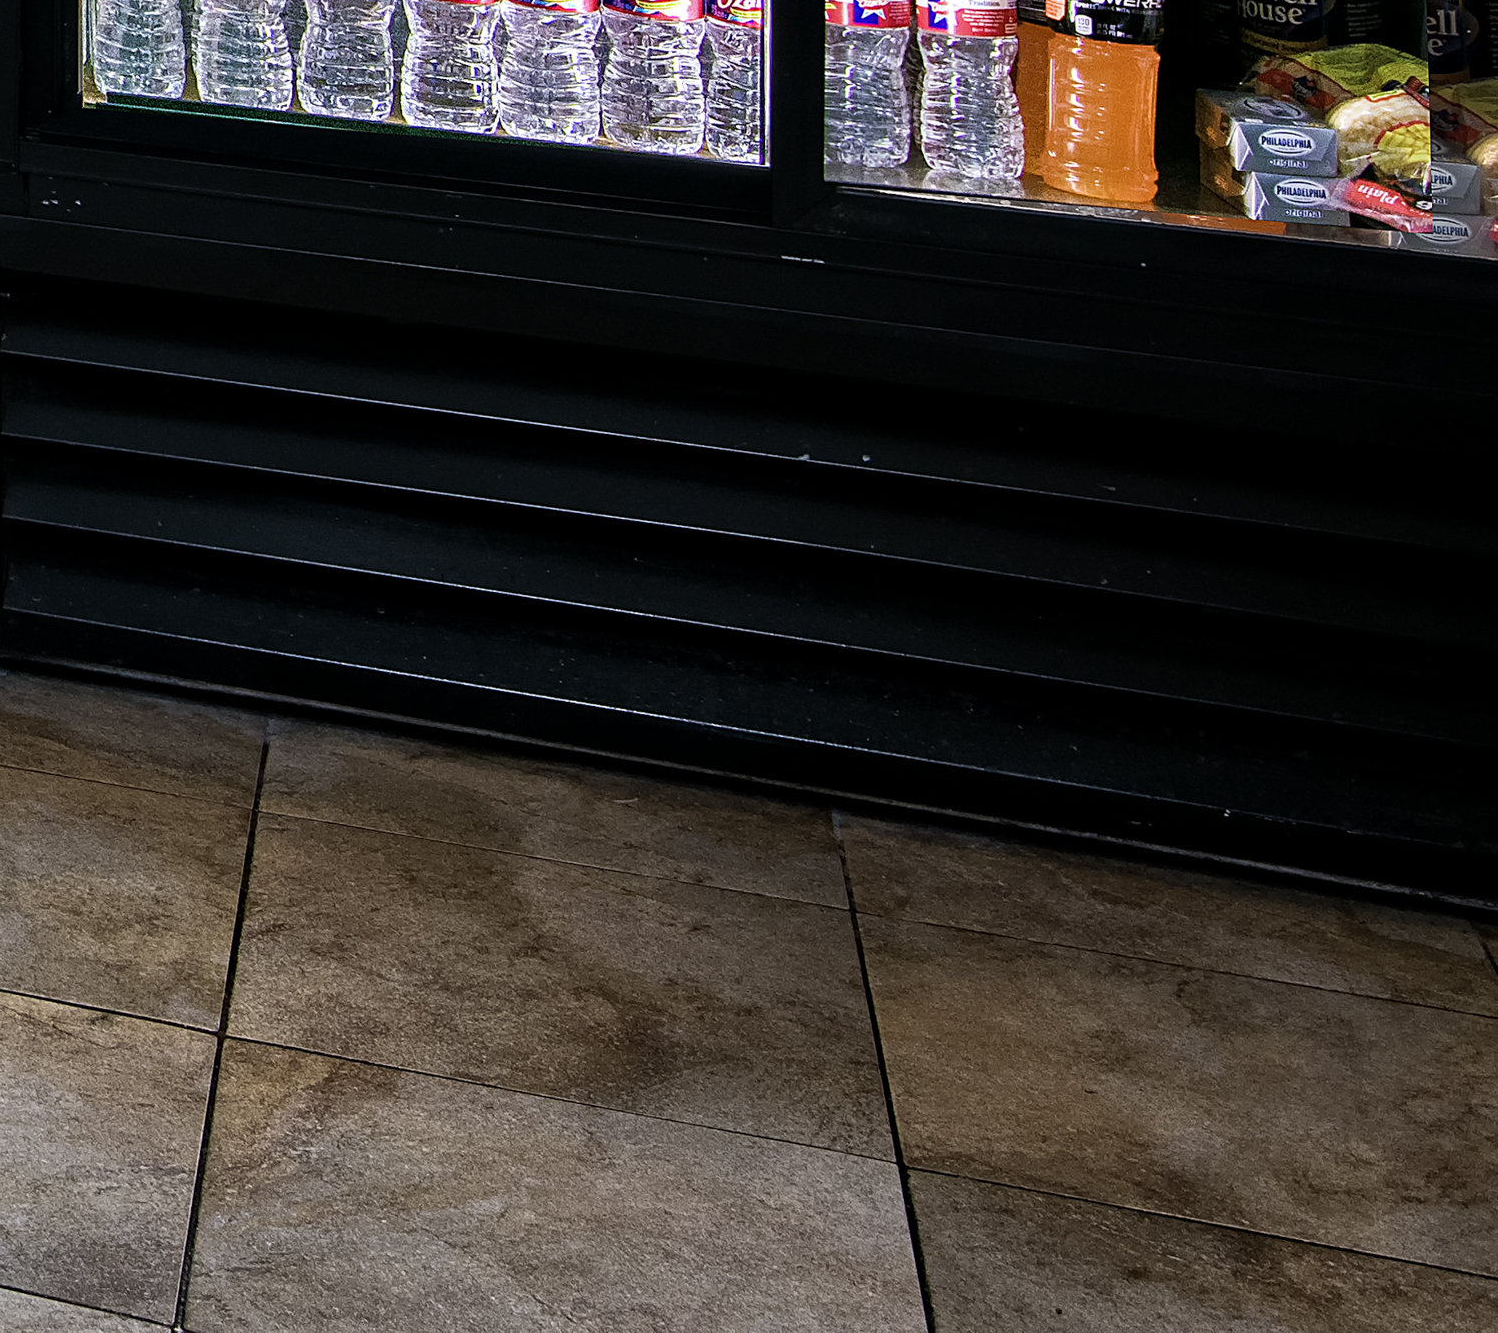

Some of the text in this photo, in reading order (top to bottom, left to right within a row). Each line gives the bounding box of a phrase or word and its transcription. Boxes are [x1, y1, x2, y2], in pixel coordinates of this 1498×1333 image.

[1261, 135, 1312, 150] PHILADELPHIA
[1277, 184, 1327, 199] PHILADELPHIA
[1357, 185, 1398, 205] Plain
